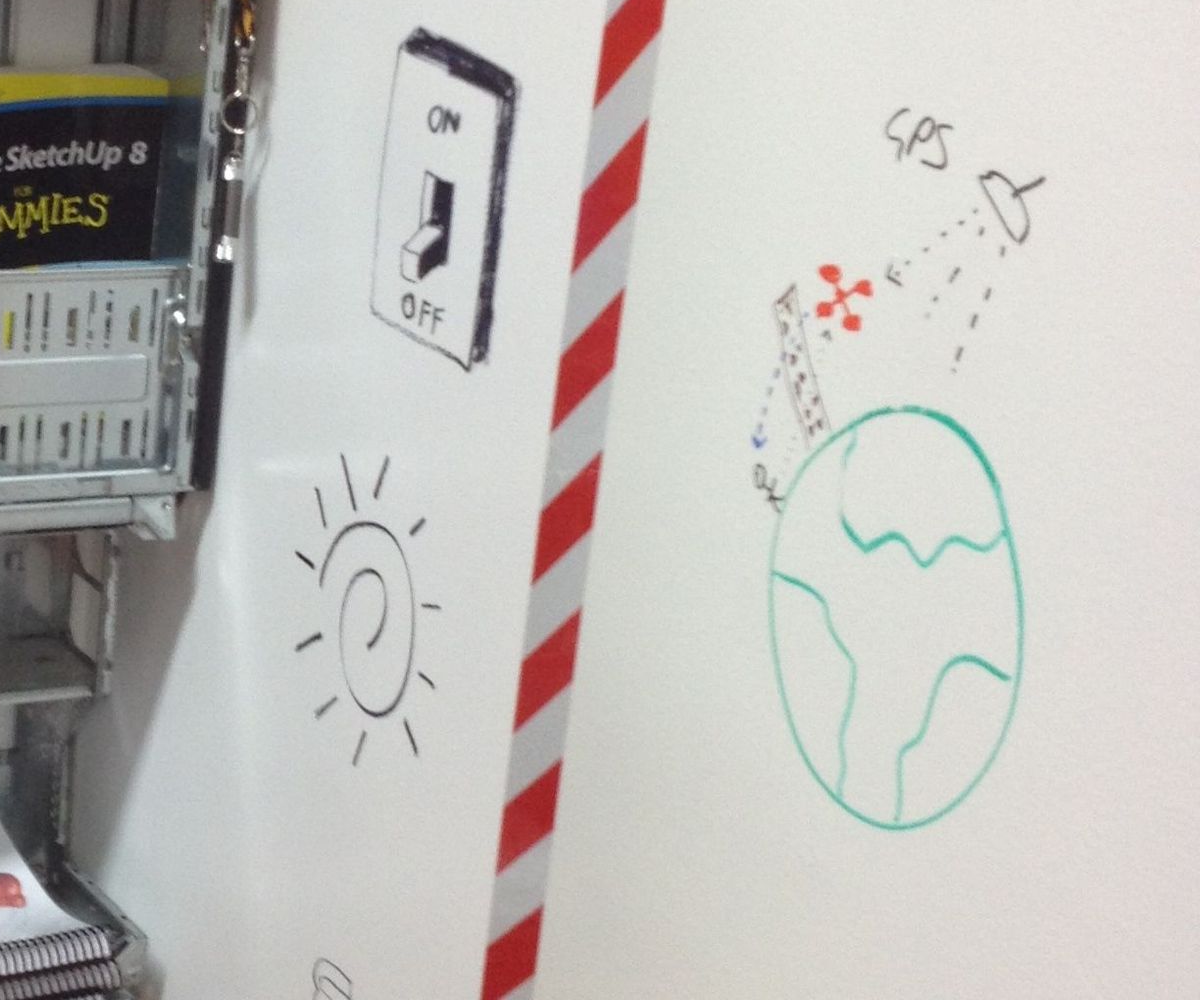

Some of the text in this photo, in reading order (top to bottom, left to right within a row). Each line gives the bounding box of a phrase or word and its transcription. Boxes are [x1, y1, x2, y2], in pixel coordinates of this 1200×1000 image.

[427, 105, 461, 135] ON
[4, 139, 123, 172] SketchUp
[128, 140, 149, 166] 8
[401, 292, 446, 335] OFF
